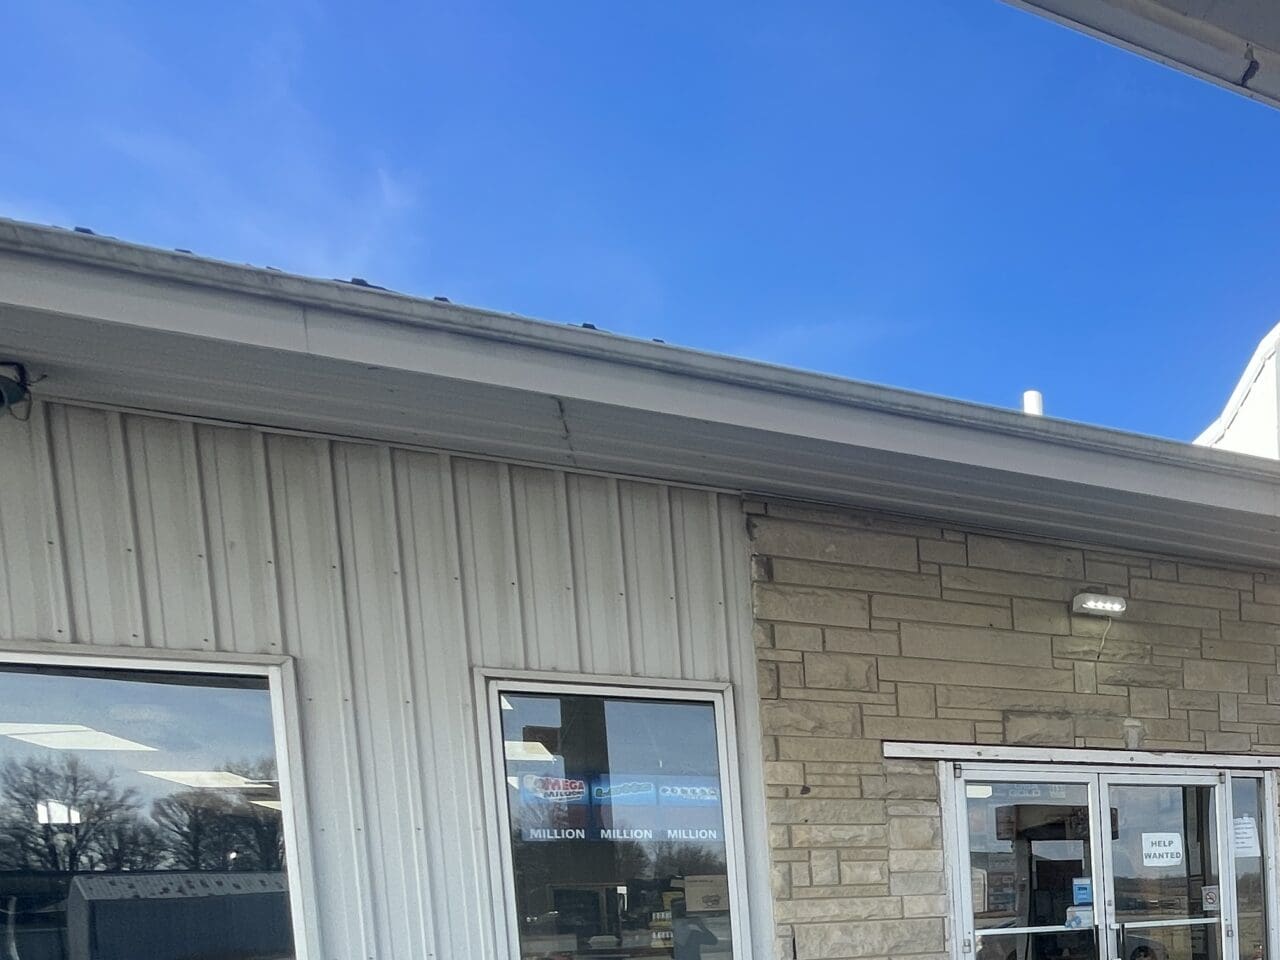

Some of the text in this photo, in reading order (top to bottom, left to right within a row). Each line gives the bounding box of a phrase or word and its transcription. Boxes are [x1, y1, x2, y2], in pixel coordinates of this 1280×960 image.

[529, 829, 585, 839] MILLION
[600, 829, 652, 839] MILLION
[667, 829, 717, 839] MILLION
[1150, 840, 1174, 848] HELP
[1144, 851, 1182, 860] WANTED
